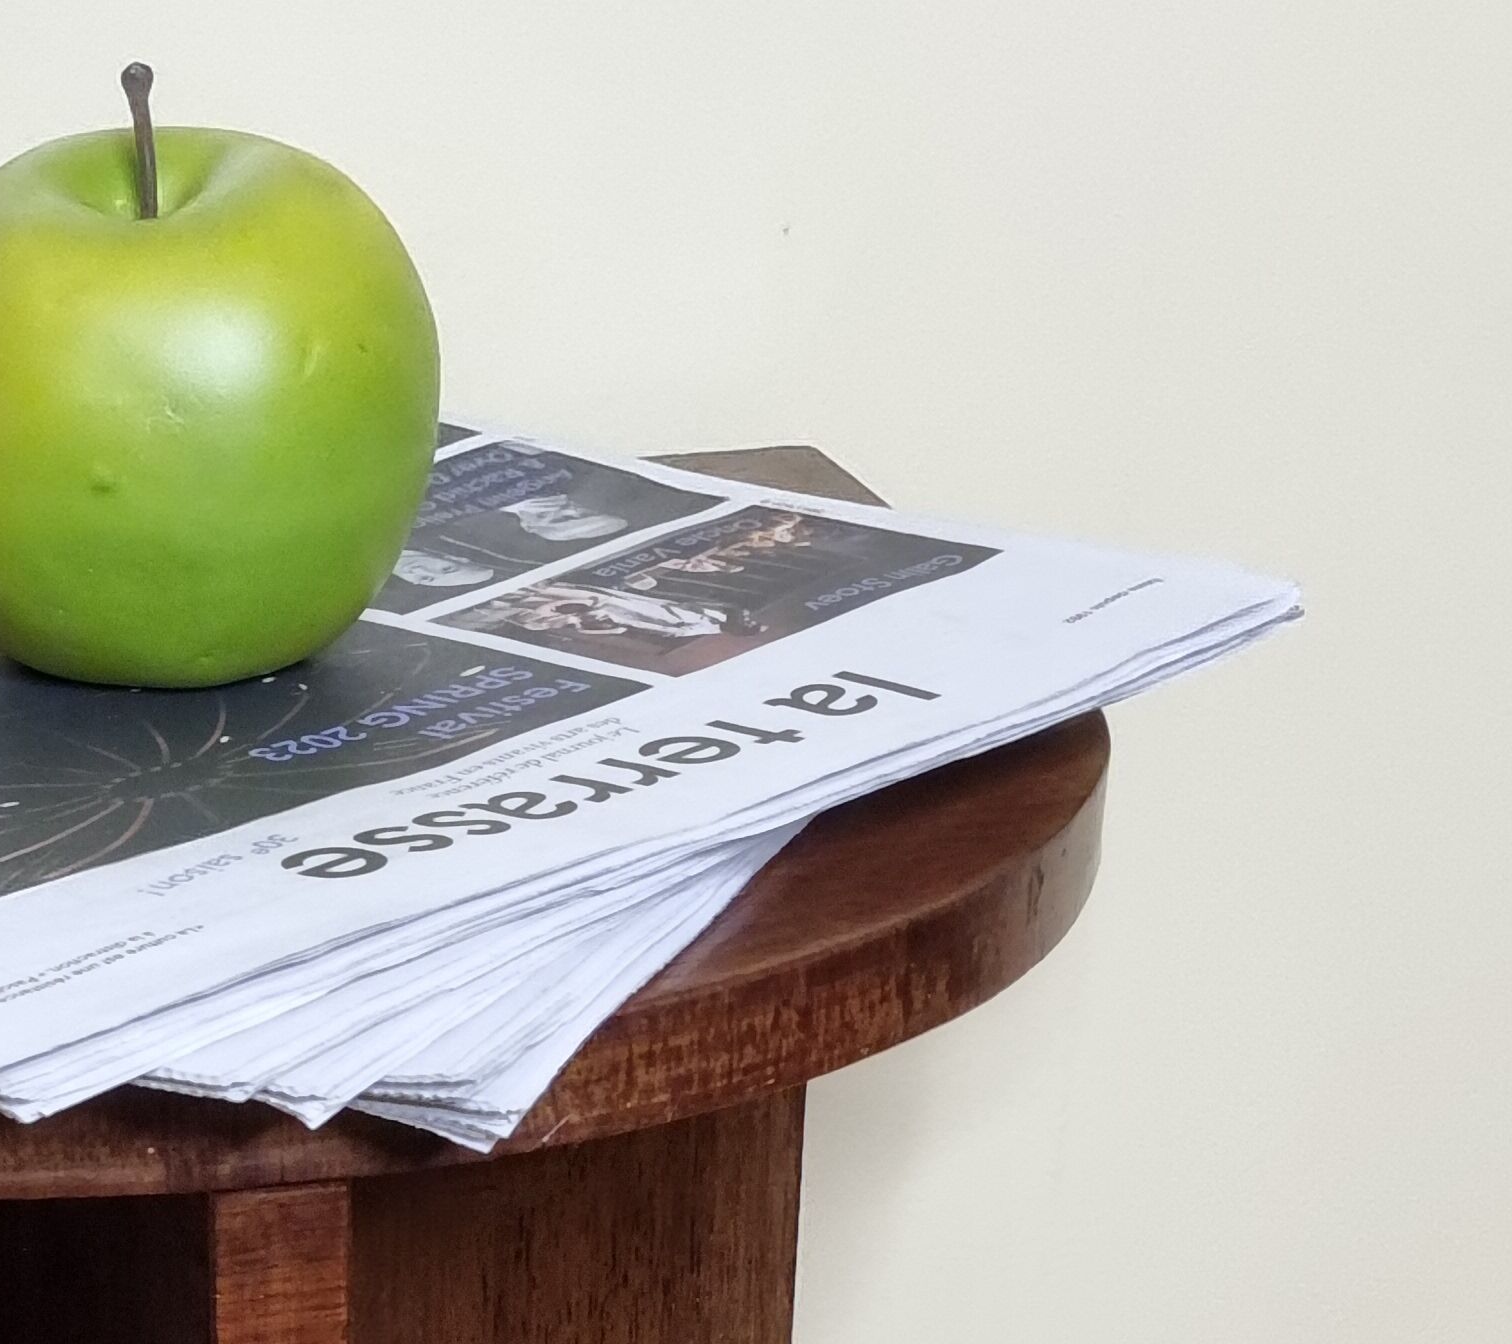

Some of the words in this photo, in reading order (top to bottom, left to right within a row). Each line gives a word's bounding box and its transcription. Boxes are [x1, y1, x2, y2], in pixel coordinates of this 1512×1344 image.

[592, 545, 681, 578] Vania
[887, 553, 962, 582] Galin
[804, 576, 892, 611] Stoev
[358, 665, 534, 728] SPRING
[762, 670, 942, 716] la
[418, 678, 592, 741] Festival
[586, 716, 623, 728] des
[248, 725, 368, 763] 2023
[550, 725, 587, 743] arts
[614, 726, 641, 737] Le
[482, 739, 548, 768] vivants
[544, 732, 611, 763] journal
[458, 765, 483, 777] en
[524, 758, 544, 773] de
[391, 774, 460, 796] France
[428, 765, 523, 799] référence
[280, 719, 807, 879] terrasse
[125, 933, 177, 954] culture
[72, 962, 100, 976] une
